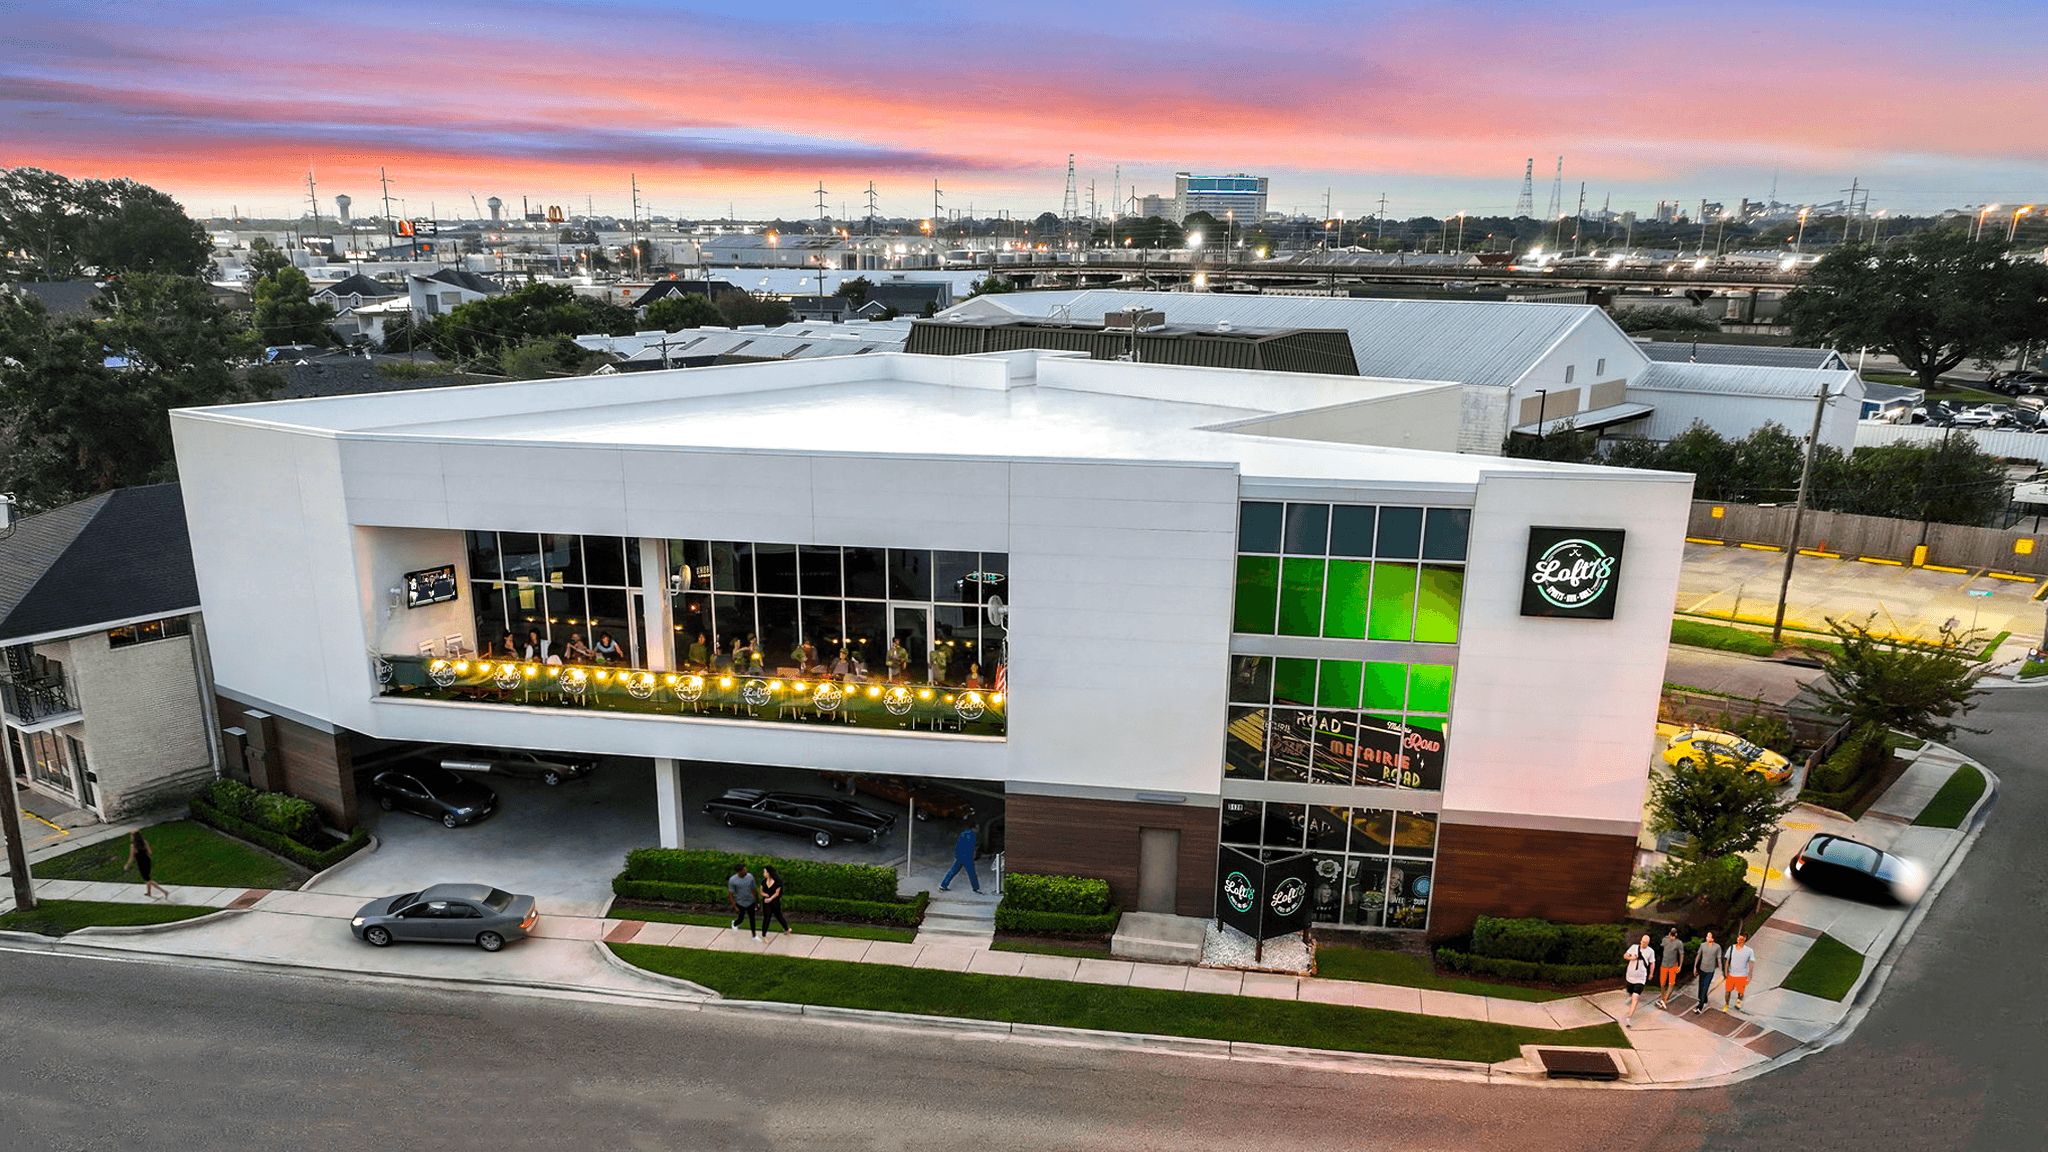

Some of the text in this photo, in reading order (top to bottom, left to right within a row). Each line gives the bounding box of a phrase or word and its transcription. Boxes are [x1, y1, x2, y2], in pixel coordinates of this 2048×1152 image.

[1531, 556, 1616, 588] Loft18
[1297, 711, 1341, 734] ROAD
[1330, 740, 1411, 770] METAIRIE
[1383, 765, 1421, 788] ROAD
[1224, 879, 1256, 900] Loft18
[1270, 882, 1307, 907] Loft18
